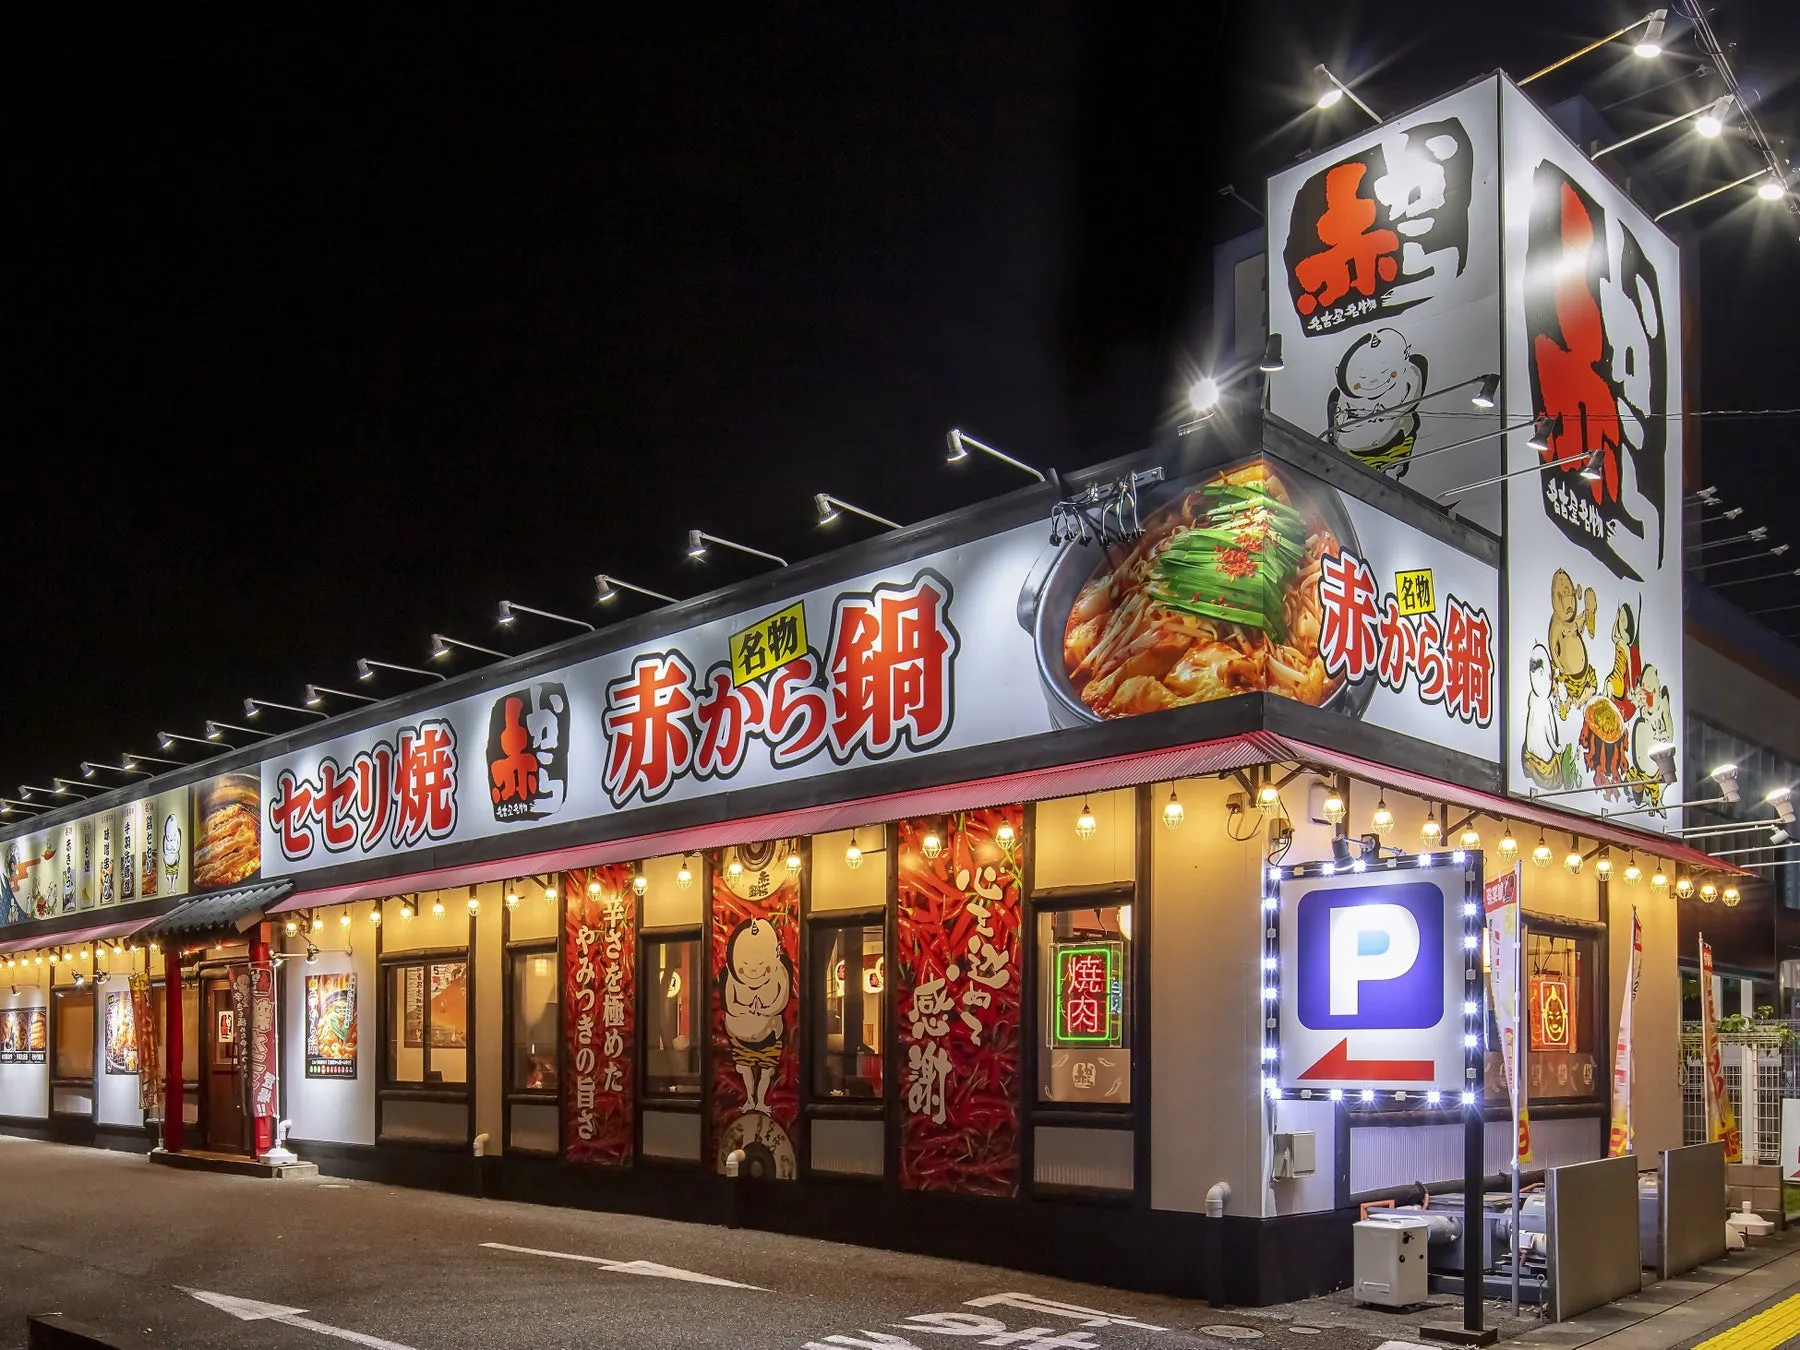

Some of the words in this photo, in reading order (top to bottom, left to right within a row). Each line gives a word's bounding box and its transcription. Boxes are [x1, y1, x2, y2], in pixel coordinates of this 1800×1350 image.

[738, 615, 798, 676] 名物
[1318, 548, 1494, 729] 赤から鍋
[1401, 574, 1431, 610] 名物
[602, 568, 961, 809] 赤から鍋
[270, 719, 458, 861] セセリ焼
[576, 925, 597, 1139] やみつきの旨さ
[602, 896, 624, 1092] 辛さを極めた
[956, 866, 1009, 1046] 心を込めて
[1068, 955, 1102, 1033] 焼肉
[1329, 903, 1420, 1016] P
[908, 965, 960, 1124] 感謝
